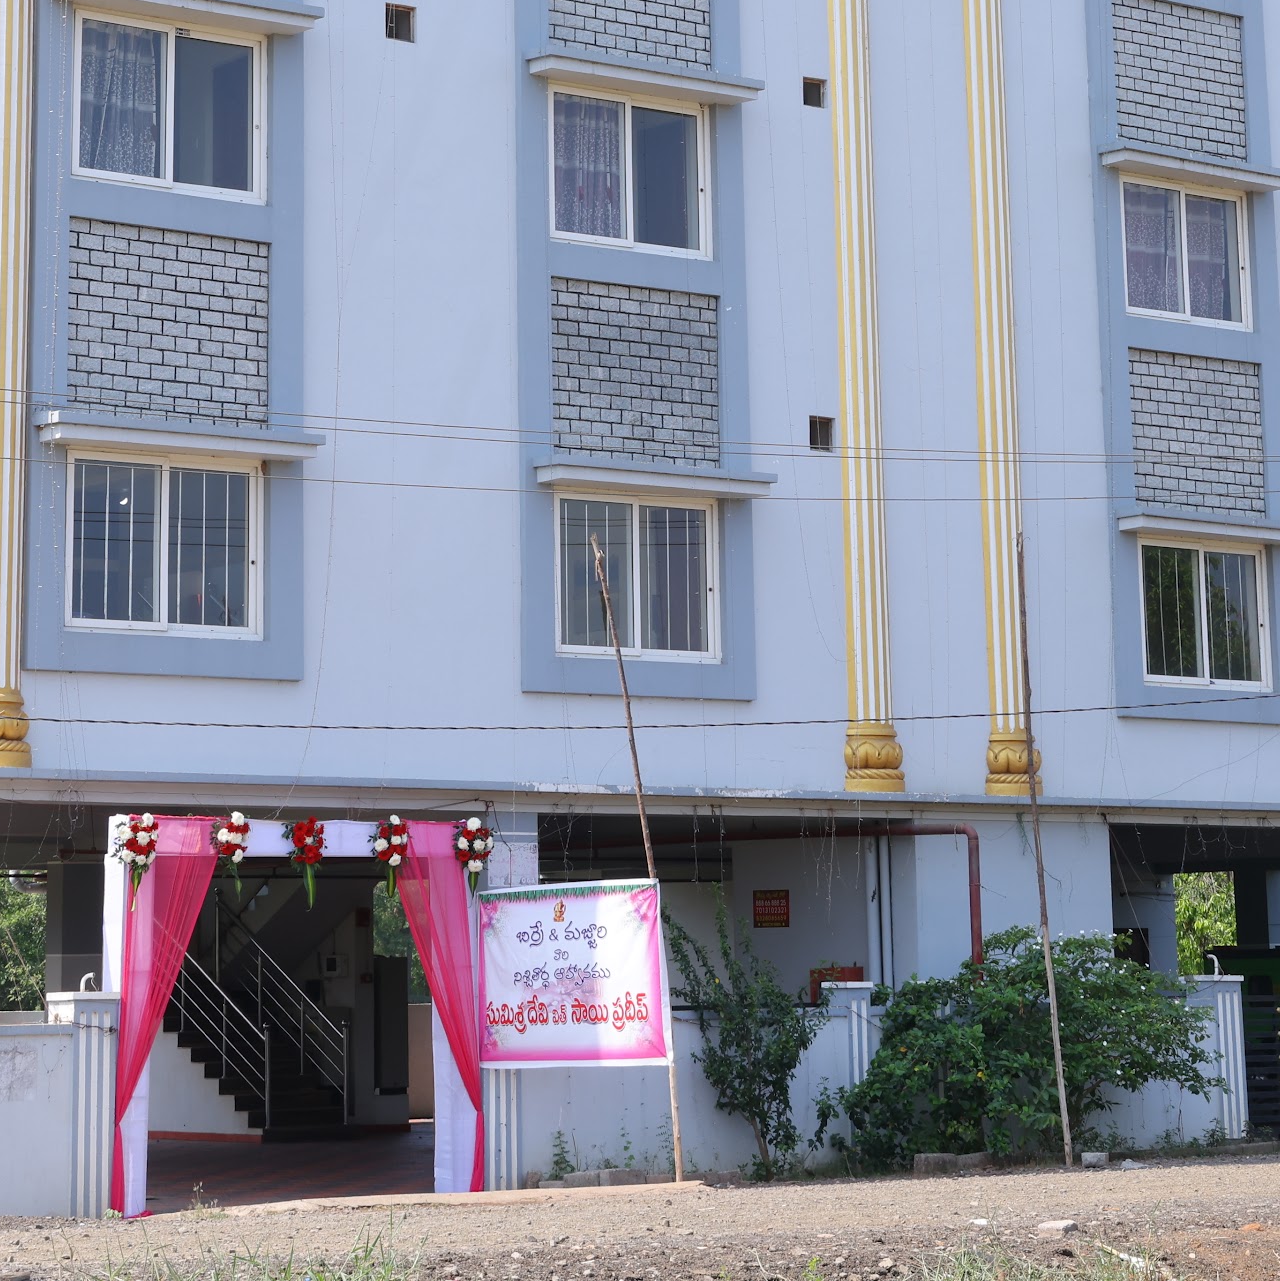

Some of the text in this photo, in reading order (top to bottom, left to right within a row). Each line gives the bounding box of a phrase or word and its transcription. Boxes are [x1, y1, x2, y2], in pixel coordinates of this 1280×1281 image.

[549, 928, 558, 941] &
[553, 949, 569, 960] వారి
[571, 997, 609, 1025] సాయి
[612, 991, 649, 1032] ప్రదీప్
